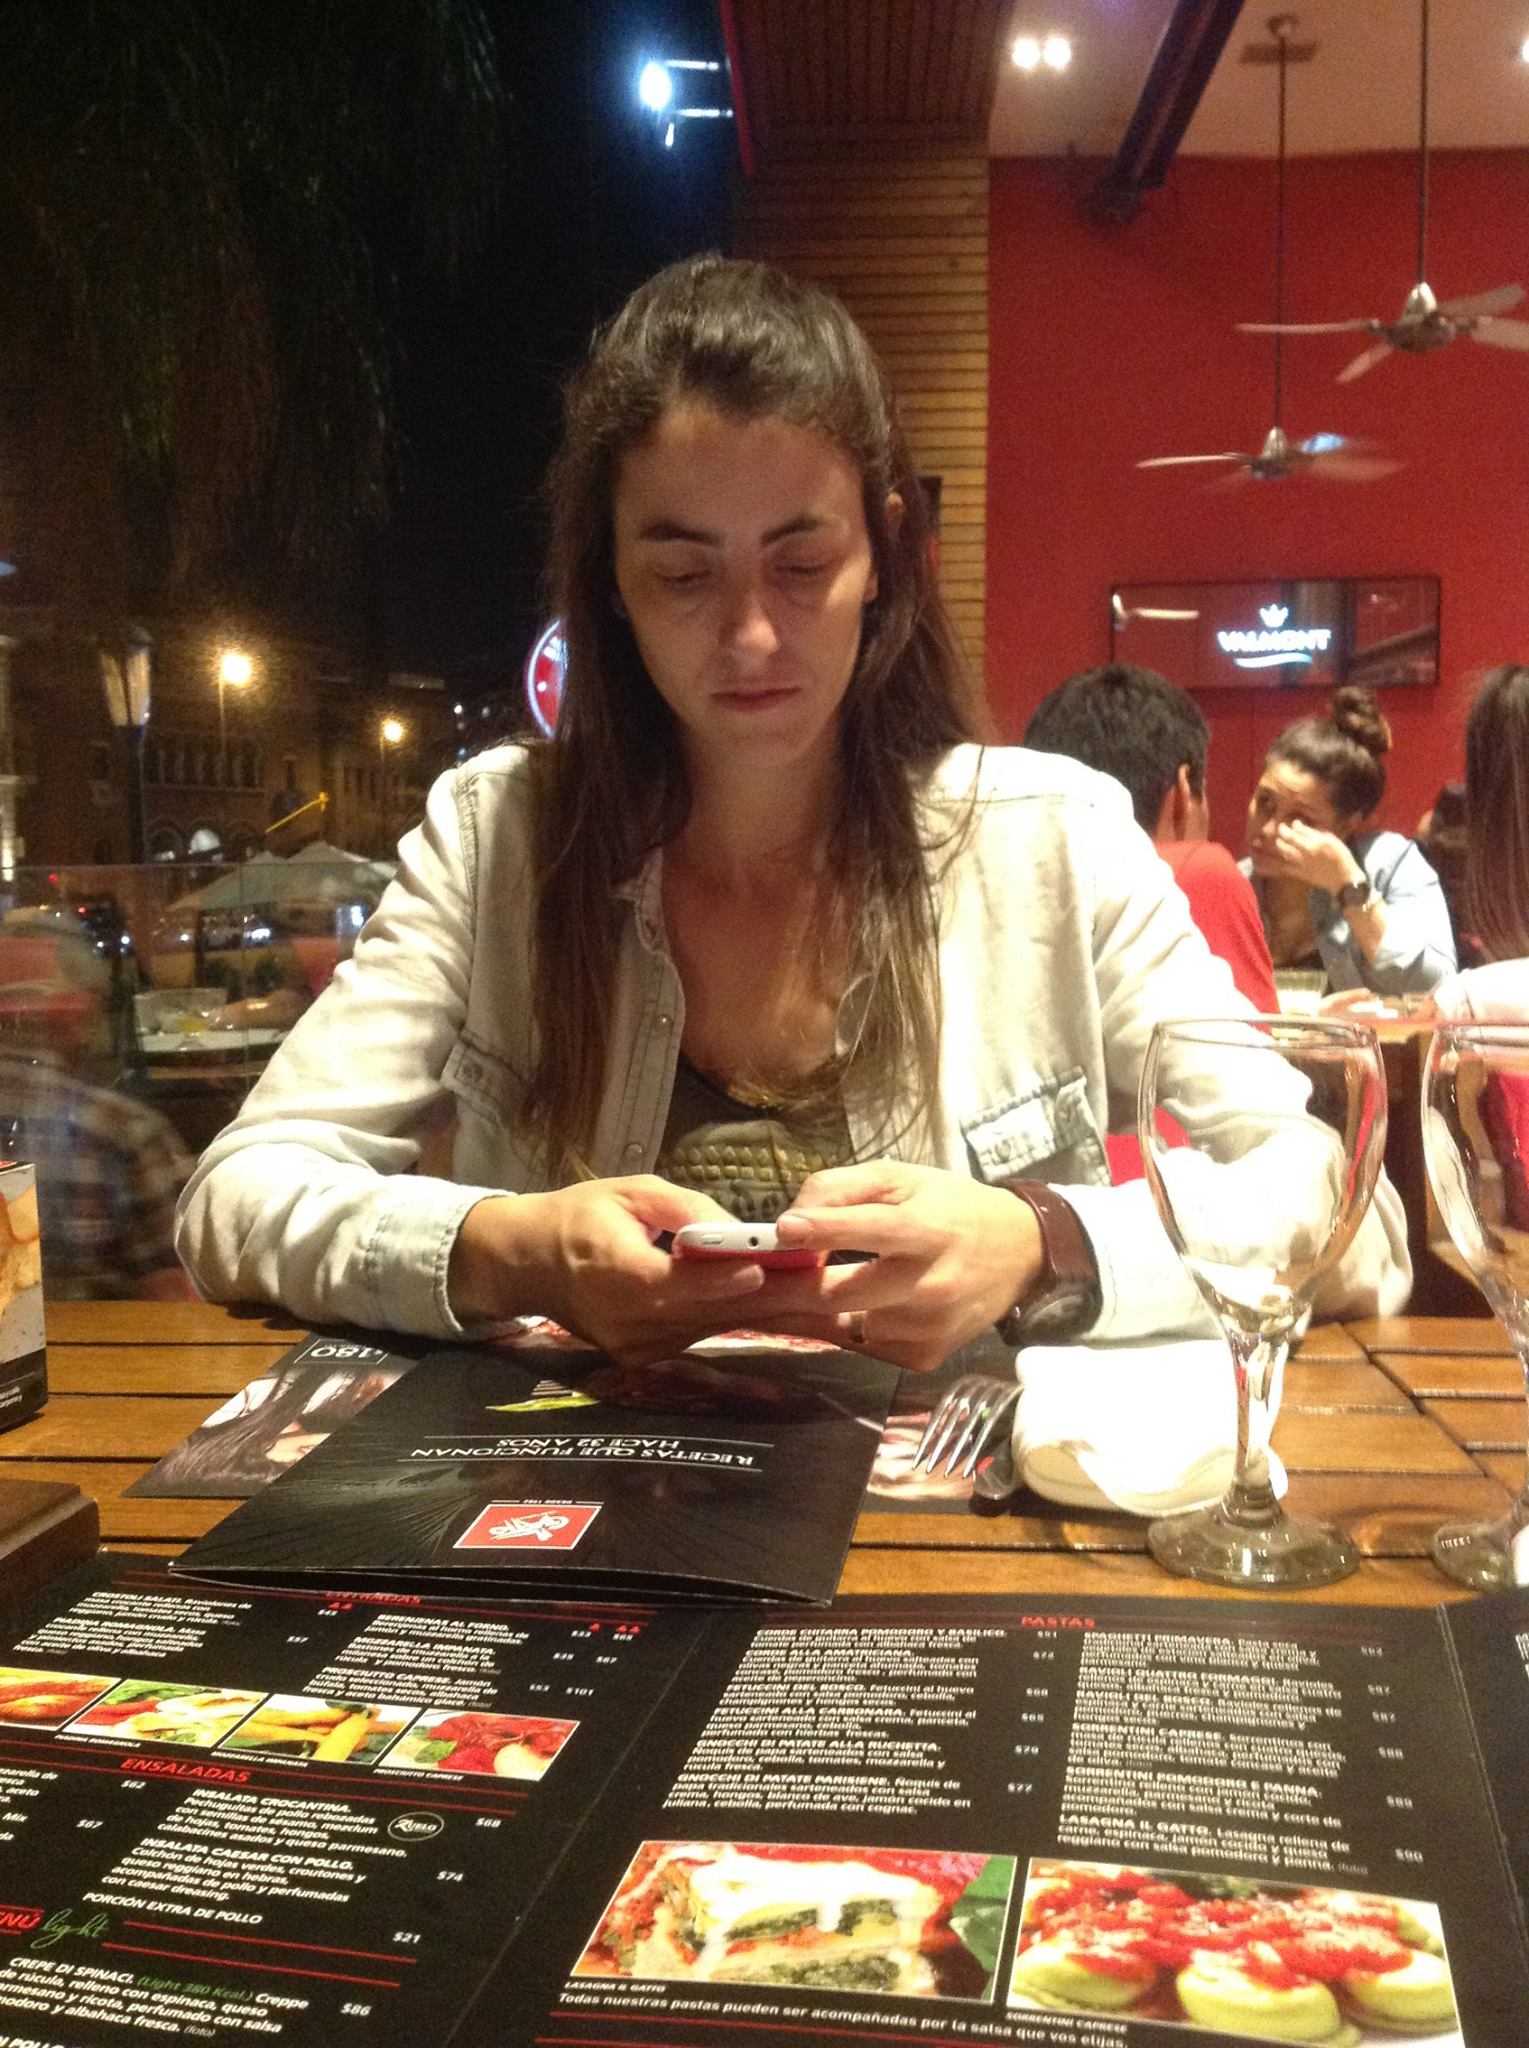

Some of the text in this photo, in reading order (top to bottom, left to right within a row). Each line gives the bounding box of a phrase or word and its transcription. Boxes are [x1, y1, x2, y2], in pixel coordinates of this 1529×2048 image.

[496, 1438, 680, 1450] HACE 32 AÑOS
[410, 1447, 754, 1466] RECETAS QUE FUNCIONAN
[1022, 1616, 1095, 1628] PASTAS
[120, 1758, 252, 1782] ENSALADAS
[121, 1780, 146, 1789] $62
[183, 1797, 258, 1813] Pechuguitas
[276, 1808, 310, 1818] pollo
[311, 1812, 376, 1823] rebozadas
[193, 1789, 352, 1812] INSALATA CROCANTINA.
[2, 1812, 28, 1822] Mix
[76, 1820, 103, 1829] $67
[184, 1816, 222, 1828] hojas,
[224, 1822, 277, 1833] tomates,
[279, 1828, 330, 1839] hongos,
[200, 1809, 249, 1820] semillas
[321, 1823, 378, 1832] mezclum
[158, 1822, 229, 1837] calabacines
[230, 1832, 273, 1843] asados
[285, 1839, 326, 1848] queso
[328, 1843, 408, 1855] parmesano.
[131, 1846, 183, 1860] Colchón
[184, 1854, 202, 1862] de
[202, 1857, 239, 1868] hojas
[239, 1861, 286, 1875] verdes,
[288, 1868, 354, 1879] croutones
[141, 1837, 355, 1868] INSALATA CAESAR CON POLLO.
[112, 1864, 202, 1884] acompañadas
[202, 1878, 221, 1886] de
[220, 1880, 257, 1892] pollo
[268, 1886, 350, 1900] perfumadas
[120, 1857, 161, 1869] queso
[161, 1862, 221, 1877] reggiano
[242, 1873, 290, 1884] hebras,
[436, 1870, 464, 1882] $74
[102, 1876, 126, 1884] con
[128, 1879, 168, 1890] caesar
[83, 1890, 262, 1923] PORCIÓN EXTRA DE POLLO
[30, 1908, 110, 1949] light
[392, 1932, 421, 1944] $21
[0, 1969, 267, 2018] de rúcula, relleno con espinaca, queso
[8, 1958, 54, 1970] CREPE
[54, 1964, 74, 1973] DI
[73, 1967, 136, 1982] SPINACI.
[254, 1994, 308, 2010] Creppe
[51, 2005, 64, 2014] y
[64, 2006, 133, 2023] albahaca
[133, 2016, 182, 2031] fresca.
[65, 1994, 78, 2002] y
[79, 1994, 127, 2008] ricota,
[127, 2001, 212, 2022] perfumado
[214, 2016, 241, 2026] con
[244, 2018, 282, 2032] salsa
[340, 2003, 372, 2017] $86
[559, 1992, 600, 2004] Todas
[603, 1996, 668, 2008] nuestras
[670, 2000, 720, 2012] pastas
[722, 2003, 779, 2015] pueden
[782, 2007, 807, 2017] ser
[812, 2008, 917, 2027] acompañadas
[920, 2018, 948, 2030] por
[951, 2019, 967, 2031] la
[970, 2022, 1012, 2037] salsa
[1015, 2028, 1046, 2042] que
[1049, 2032, 1076, 2044] vos
